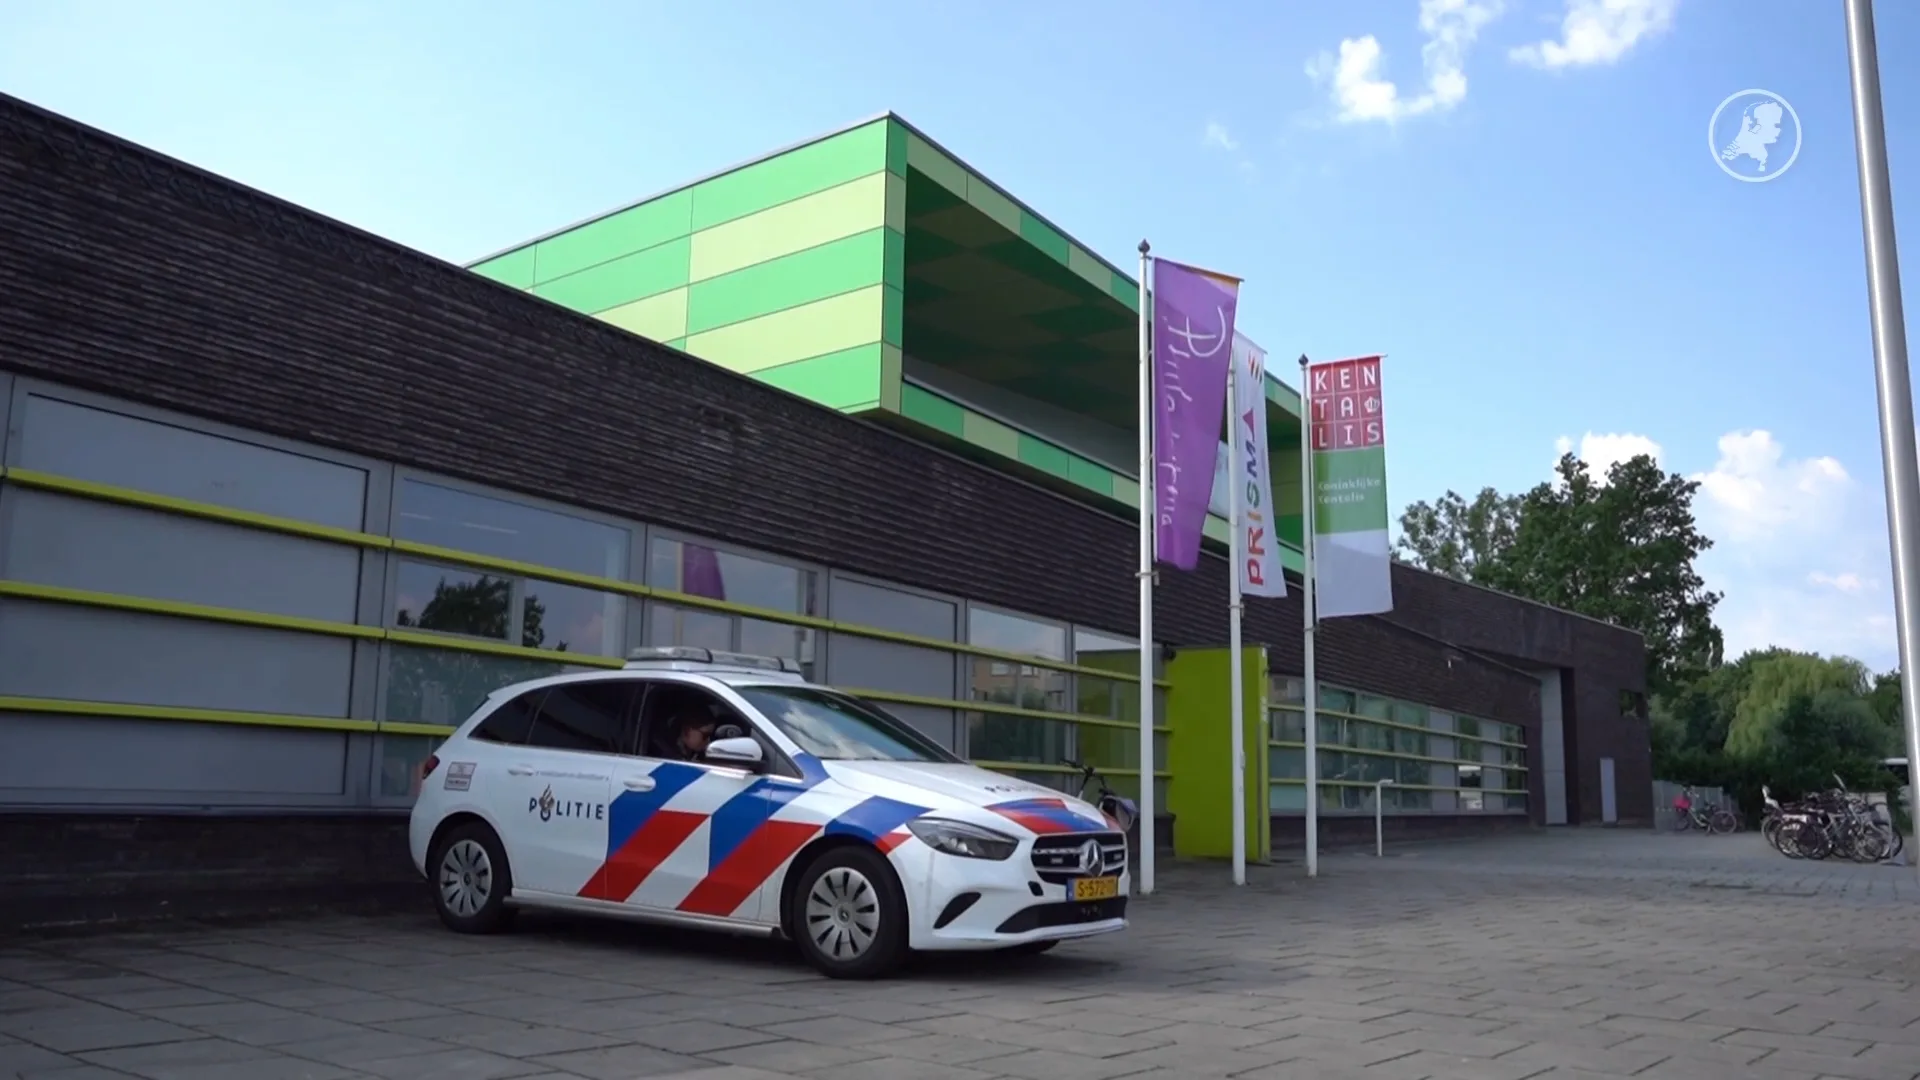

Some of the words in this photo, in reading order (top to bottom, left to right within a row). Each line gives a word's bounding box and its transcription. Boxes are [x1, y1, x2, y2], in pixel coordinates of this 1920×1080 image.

[1315, 364, 1377, 392] KEN
[1318, 421, 1381, 448] LIS
[1242, 407, 1266, 586] PRISMA
[529, 790, 604, 822] POLITIE
